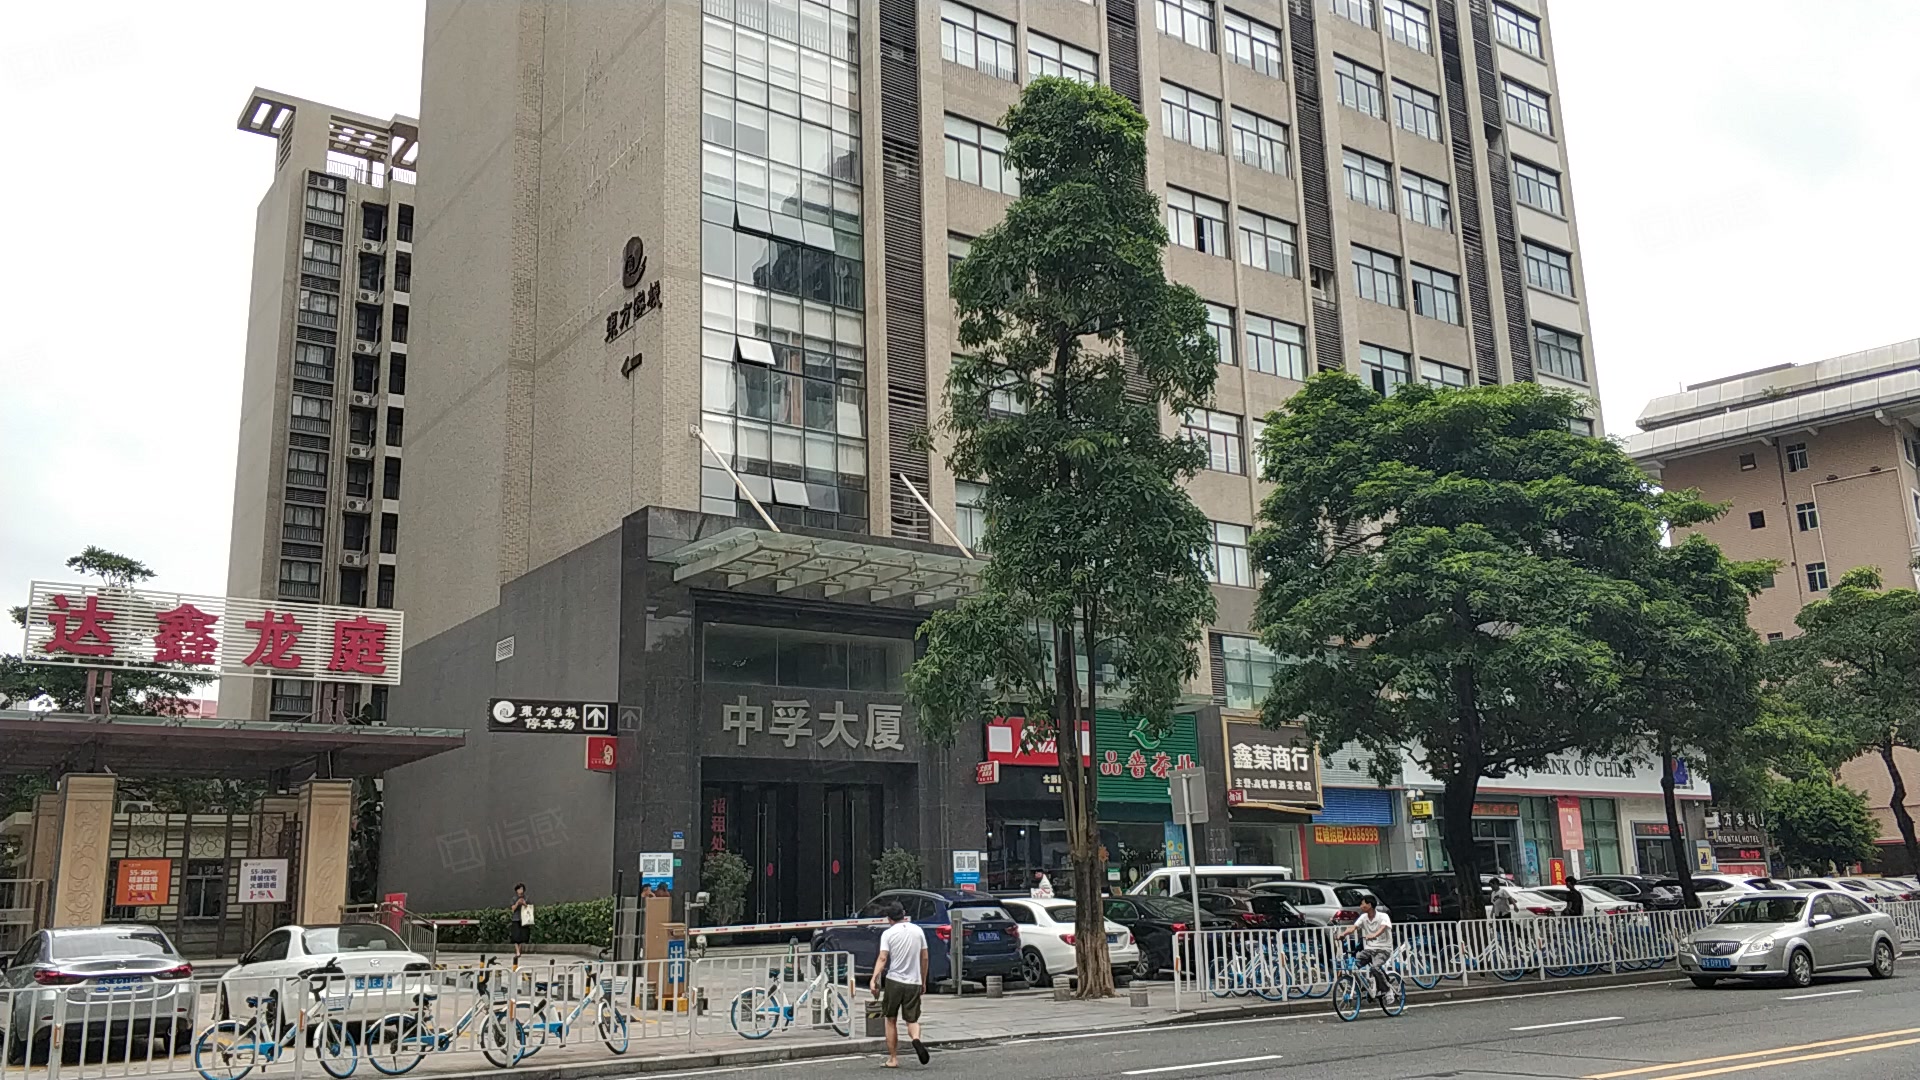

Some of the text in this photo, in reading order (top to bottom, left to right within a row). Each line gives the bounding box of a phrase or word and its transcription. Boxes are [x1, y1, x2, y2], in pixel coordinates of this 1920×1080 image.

[44, 594, 387, 674] 达鑫龙庭
[525, 718, 576, 731] 停车场
[722, 695, 905, 751] 中孚大厦
[1232, 742, 1309, 771] 鑫葉商行
[1574, 760, 1591, 776] OF
[1594, 761, 1636, 778] CHINA
[1742, 835, 1760, 843] HOTEL
